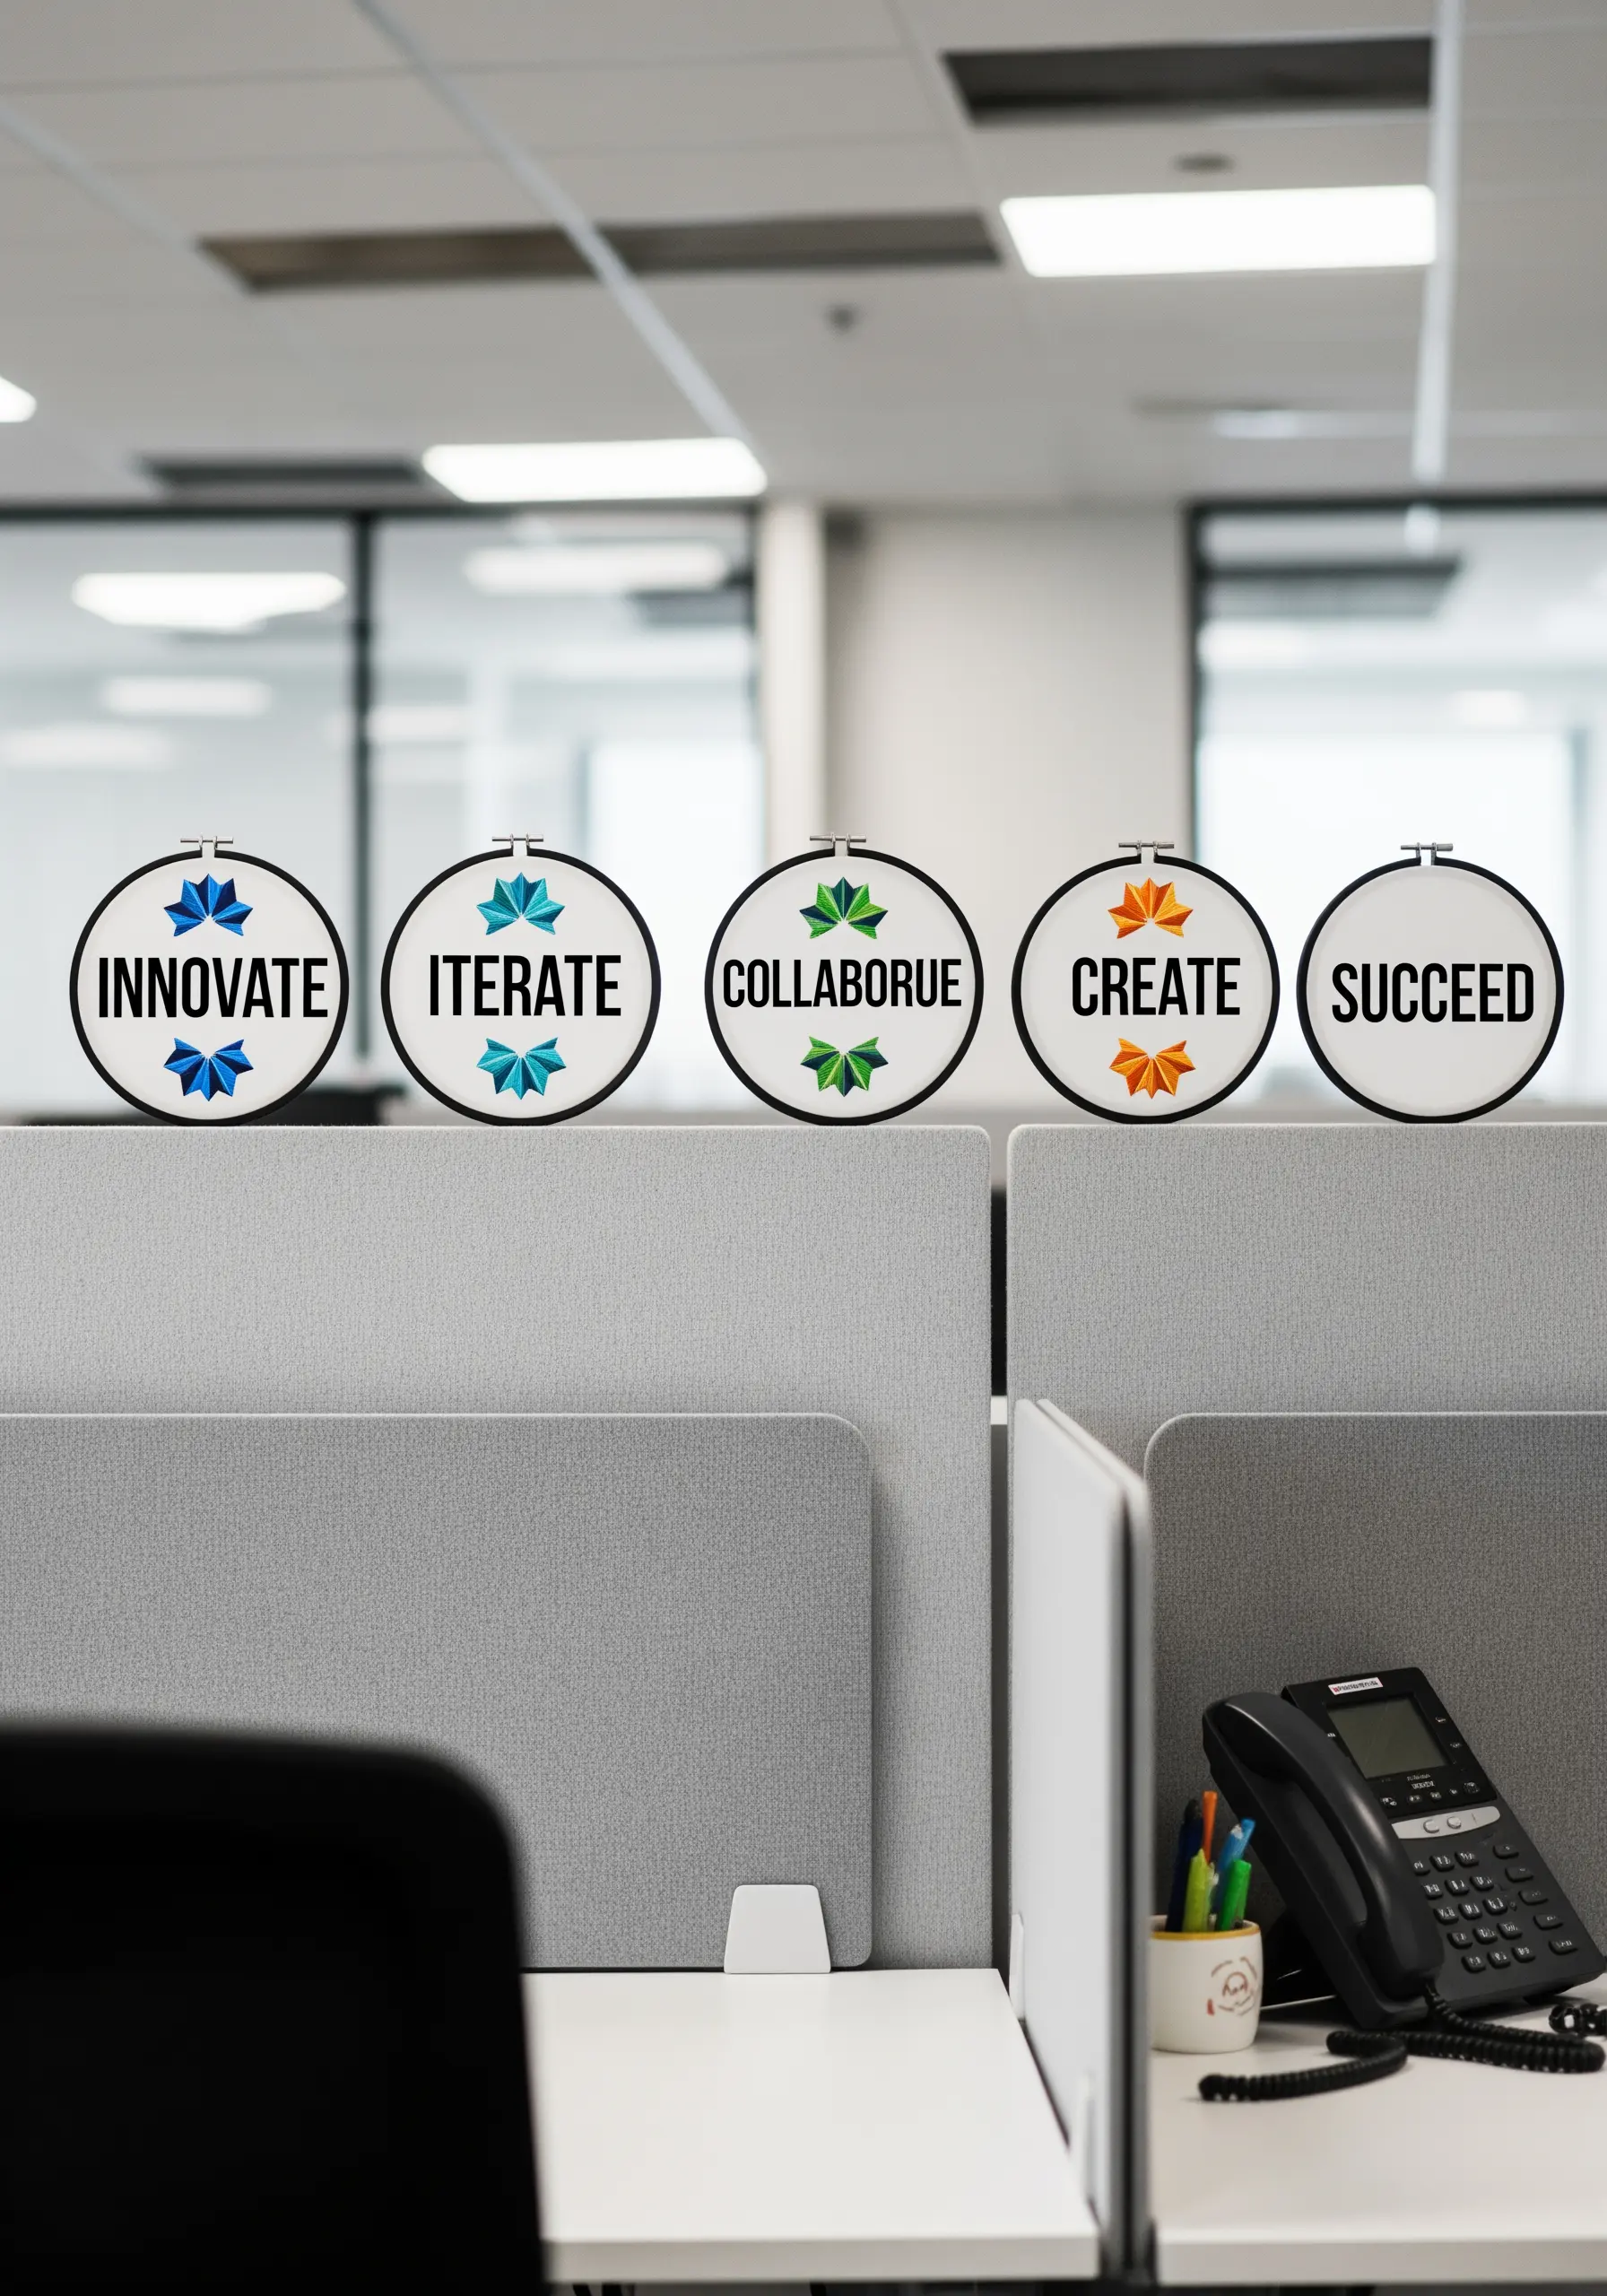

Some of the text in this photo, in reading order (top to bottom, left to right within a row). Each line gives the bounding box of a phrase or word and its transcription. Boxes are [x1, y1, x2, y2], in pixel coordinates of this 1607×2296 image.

[100, 957, 328, 1018] INNOVATE
[430, 955, 621, 1016] ITERATE
[723, 959, 962, 1008] COLLABORUE
[1072, 957, 1241, 1016] CREATE
[1333, 962, 1534, 1023] SUCCEED
